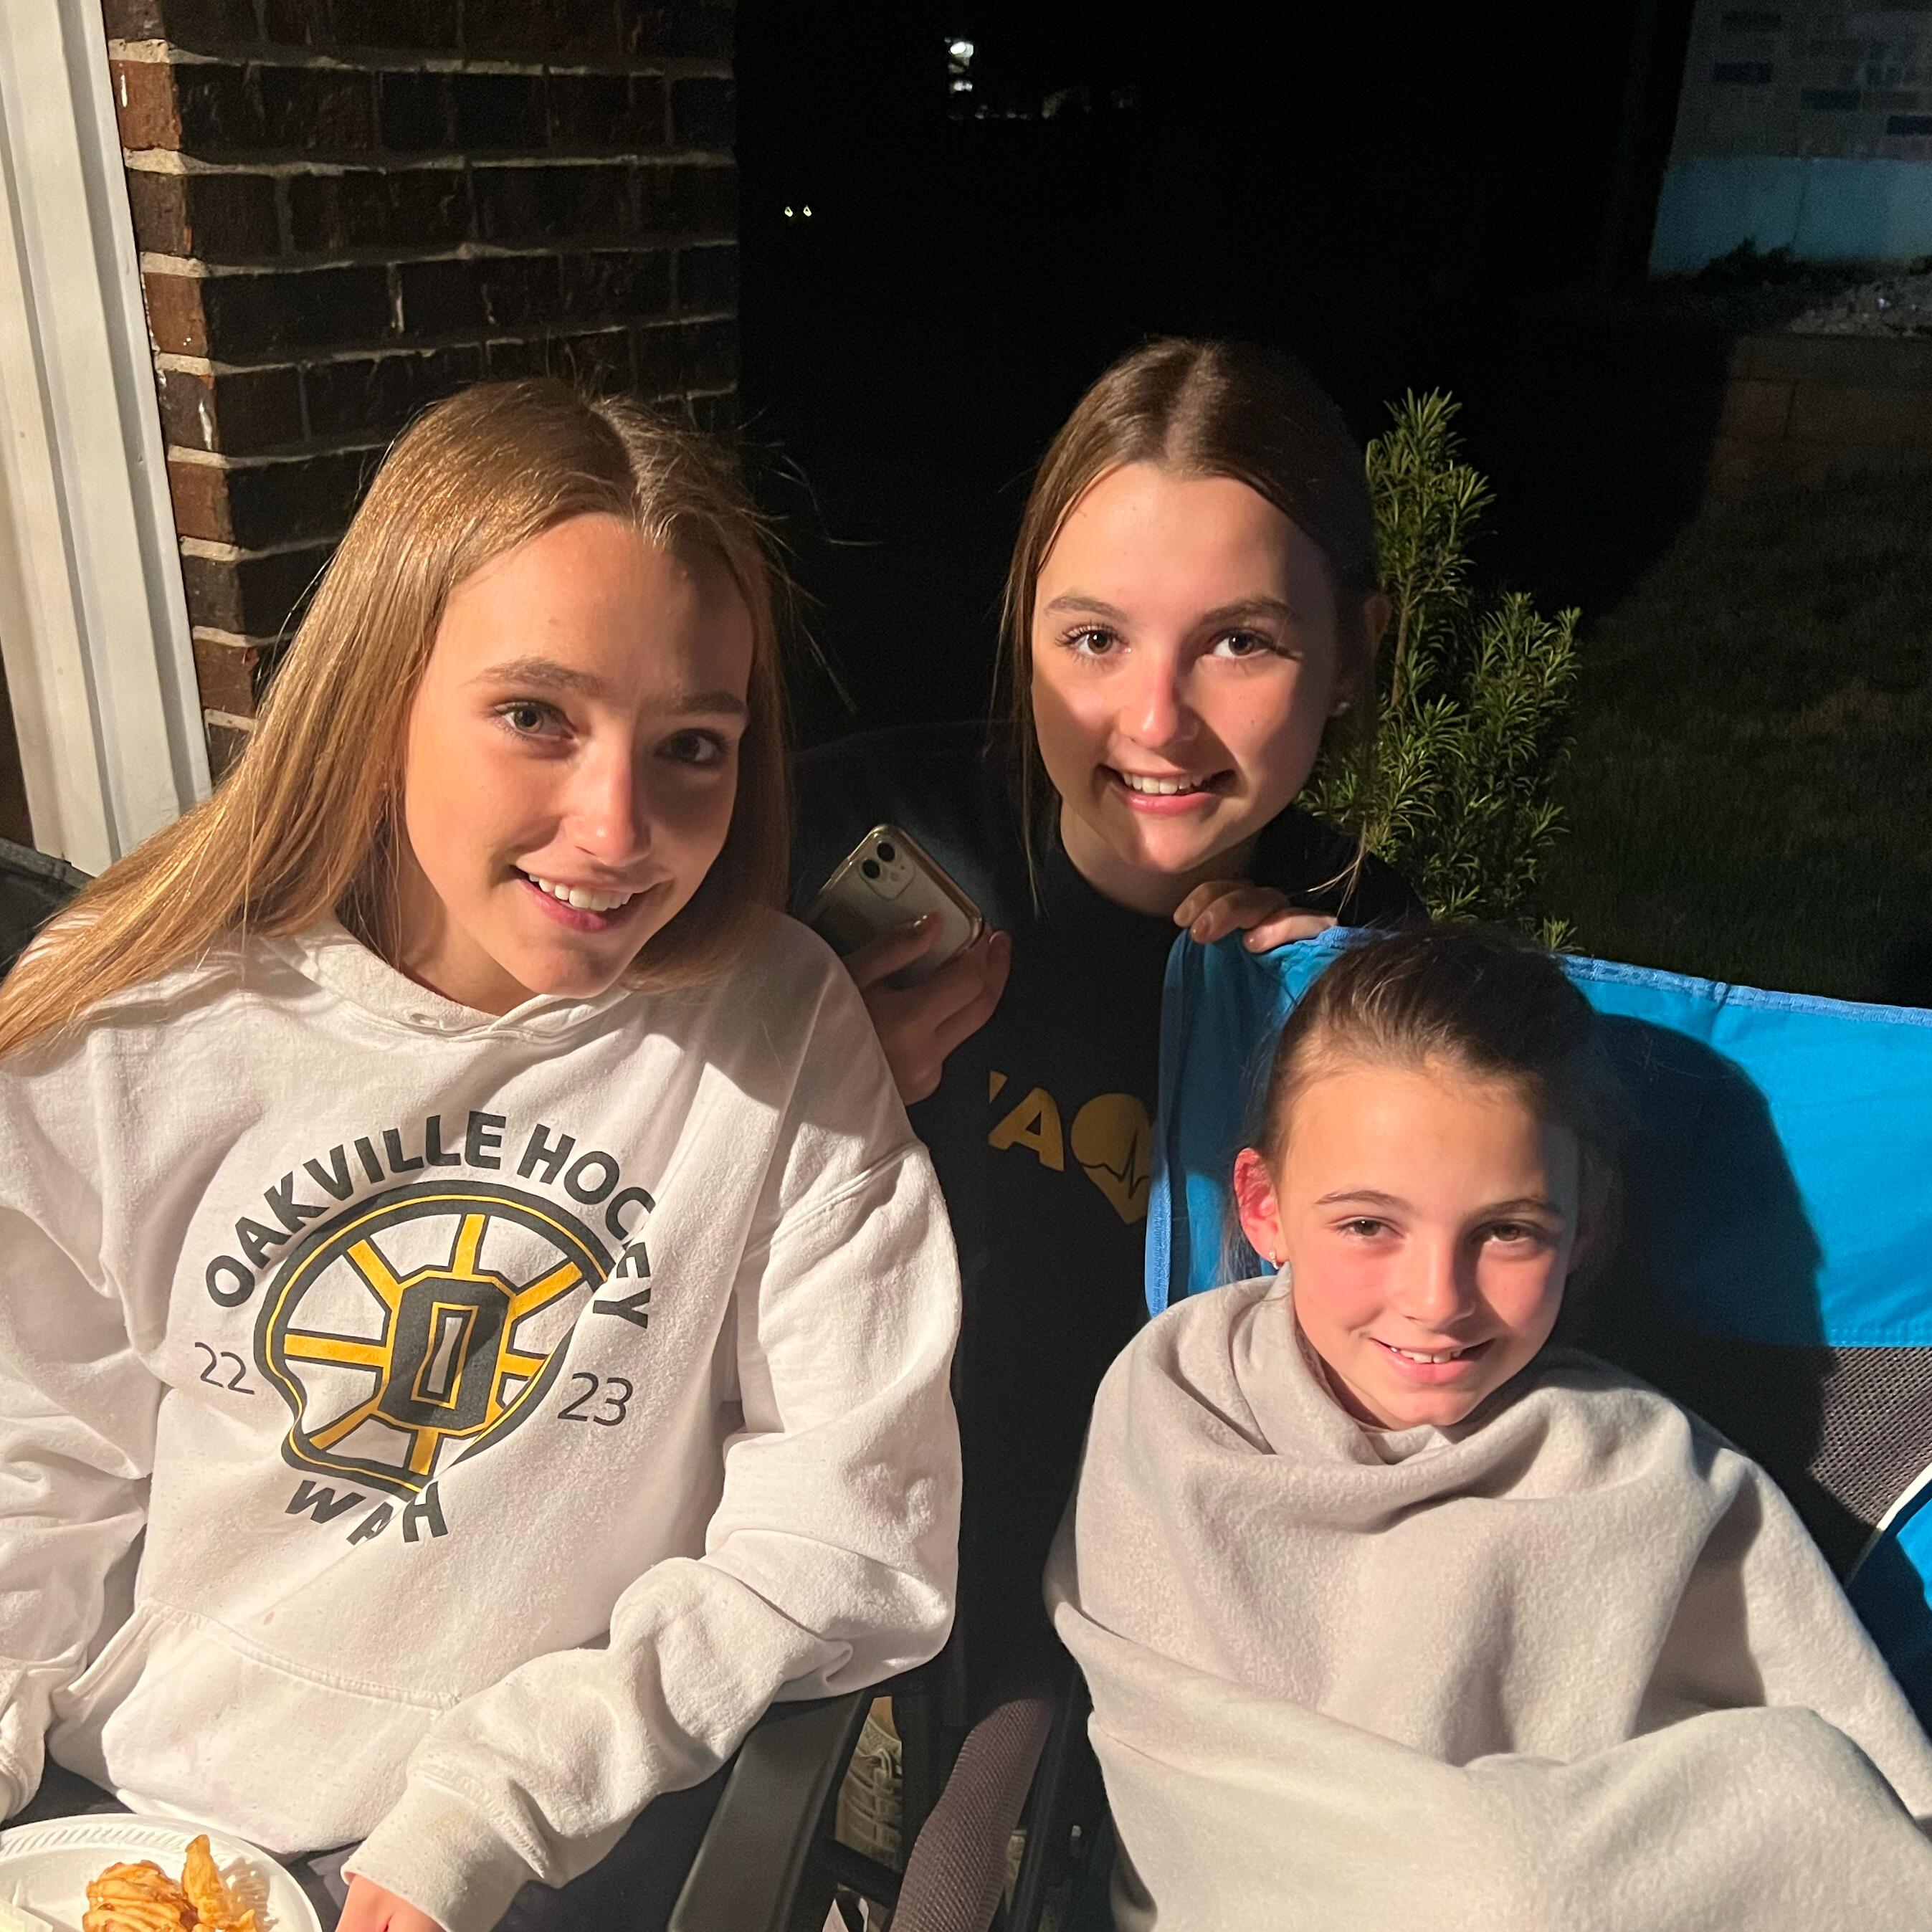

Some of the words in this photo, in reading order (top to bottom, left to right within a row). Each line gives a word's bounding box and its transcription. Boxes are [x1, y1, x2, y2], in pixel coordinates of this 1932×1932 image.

[206, 1110, 506, 1308] OAKVILLE
[517, 1123, 656, 1329] HOCEY
[194, 1342, 254, 1395] 22
[557, 1372, 634, 1427] 23
[285, 1480, 449, 1546] WAH
